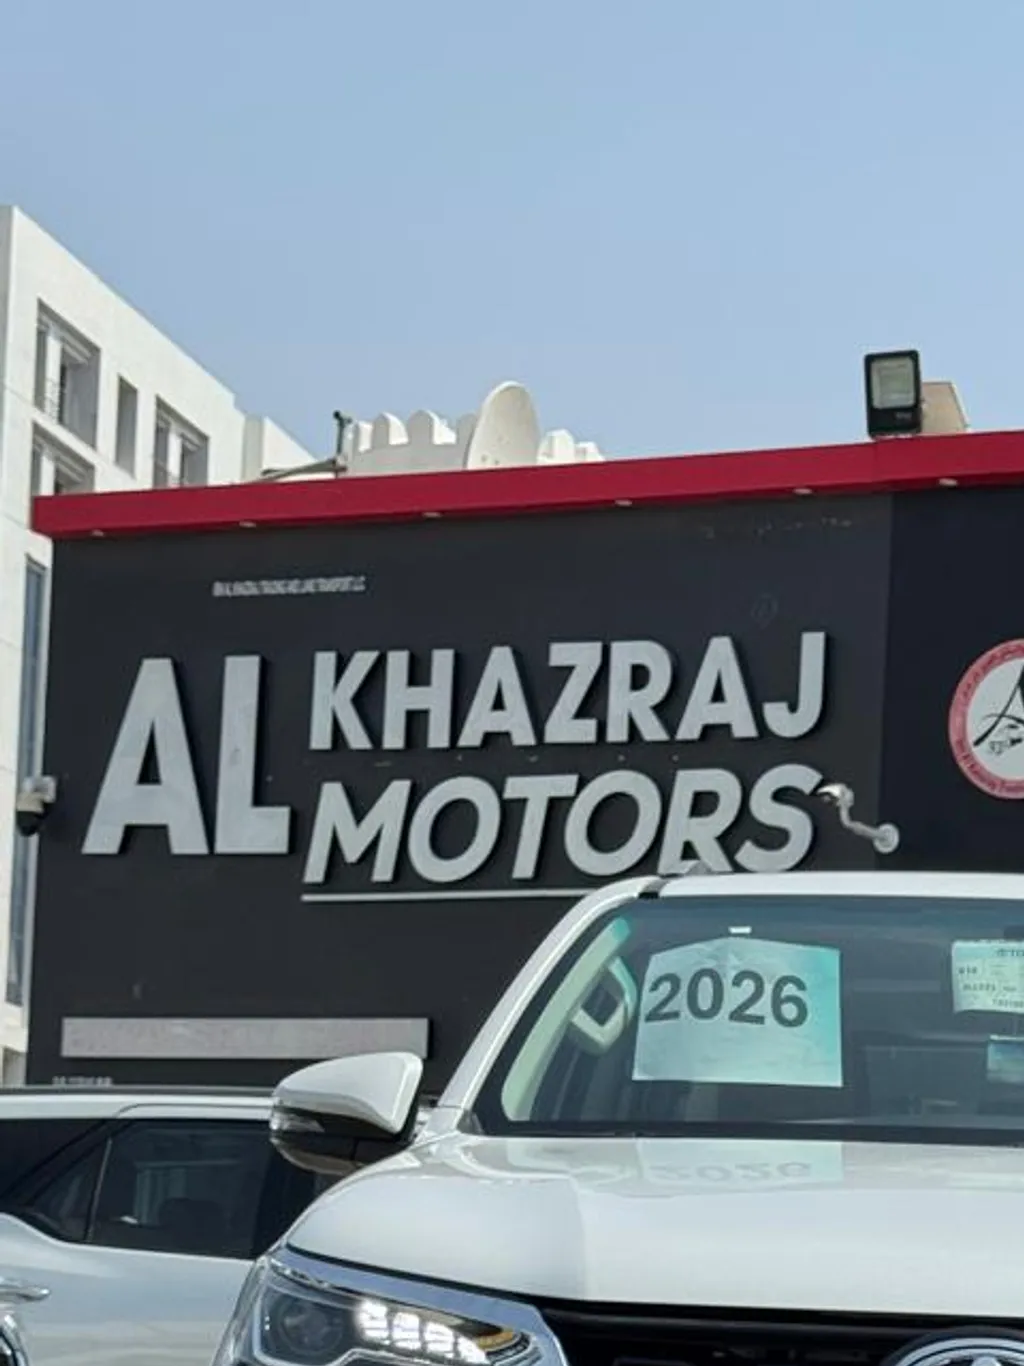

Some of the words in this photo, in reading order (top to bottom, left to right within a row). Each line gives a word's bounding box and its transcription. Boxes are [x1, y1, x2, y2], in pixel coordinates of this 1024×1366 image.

[309, 632, 826, 750] KHAZRAJ
[82, 654, 290, 855] AL
[302, 764, 823, 883] MOTORS
[644, 968, 808, 1028] 2026
